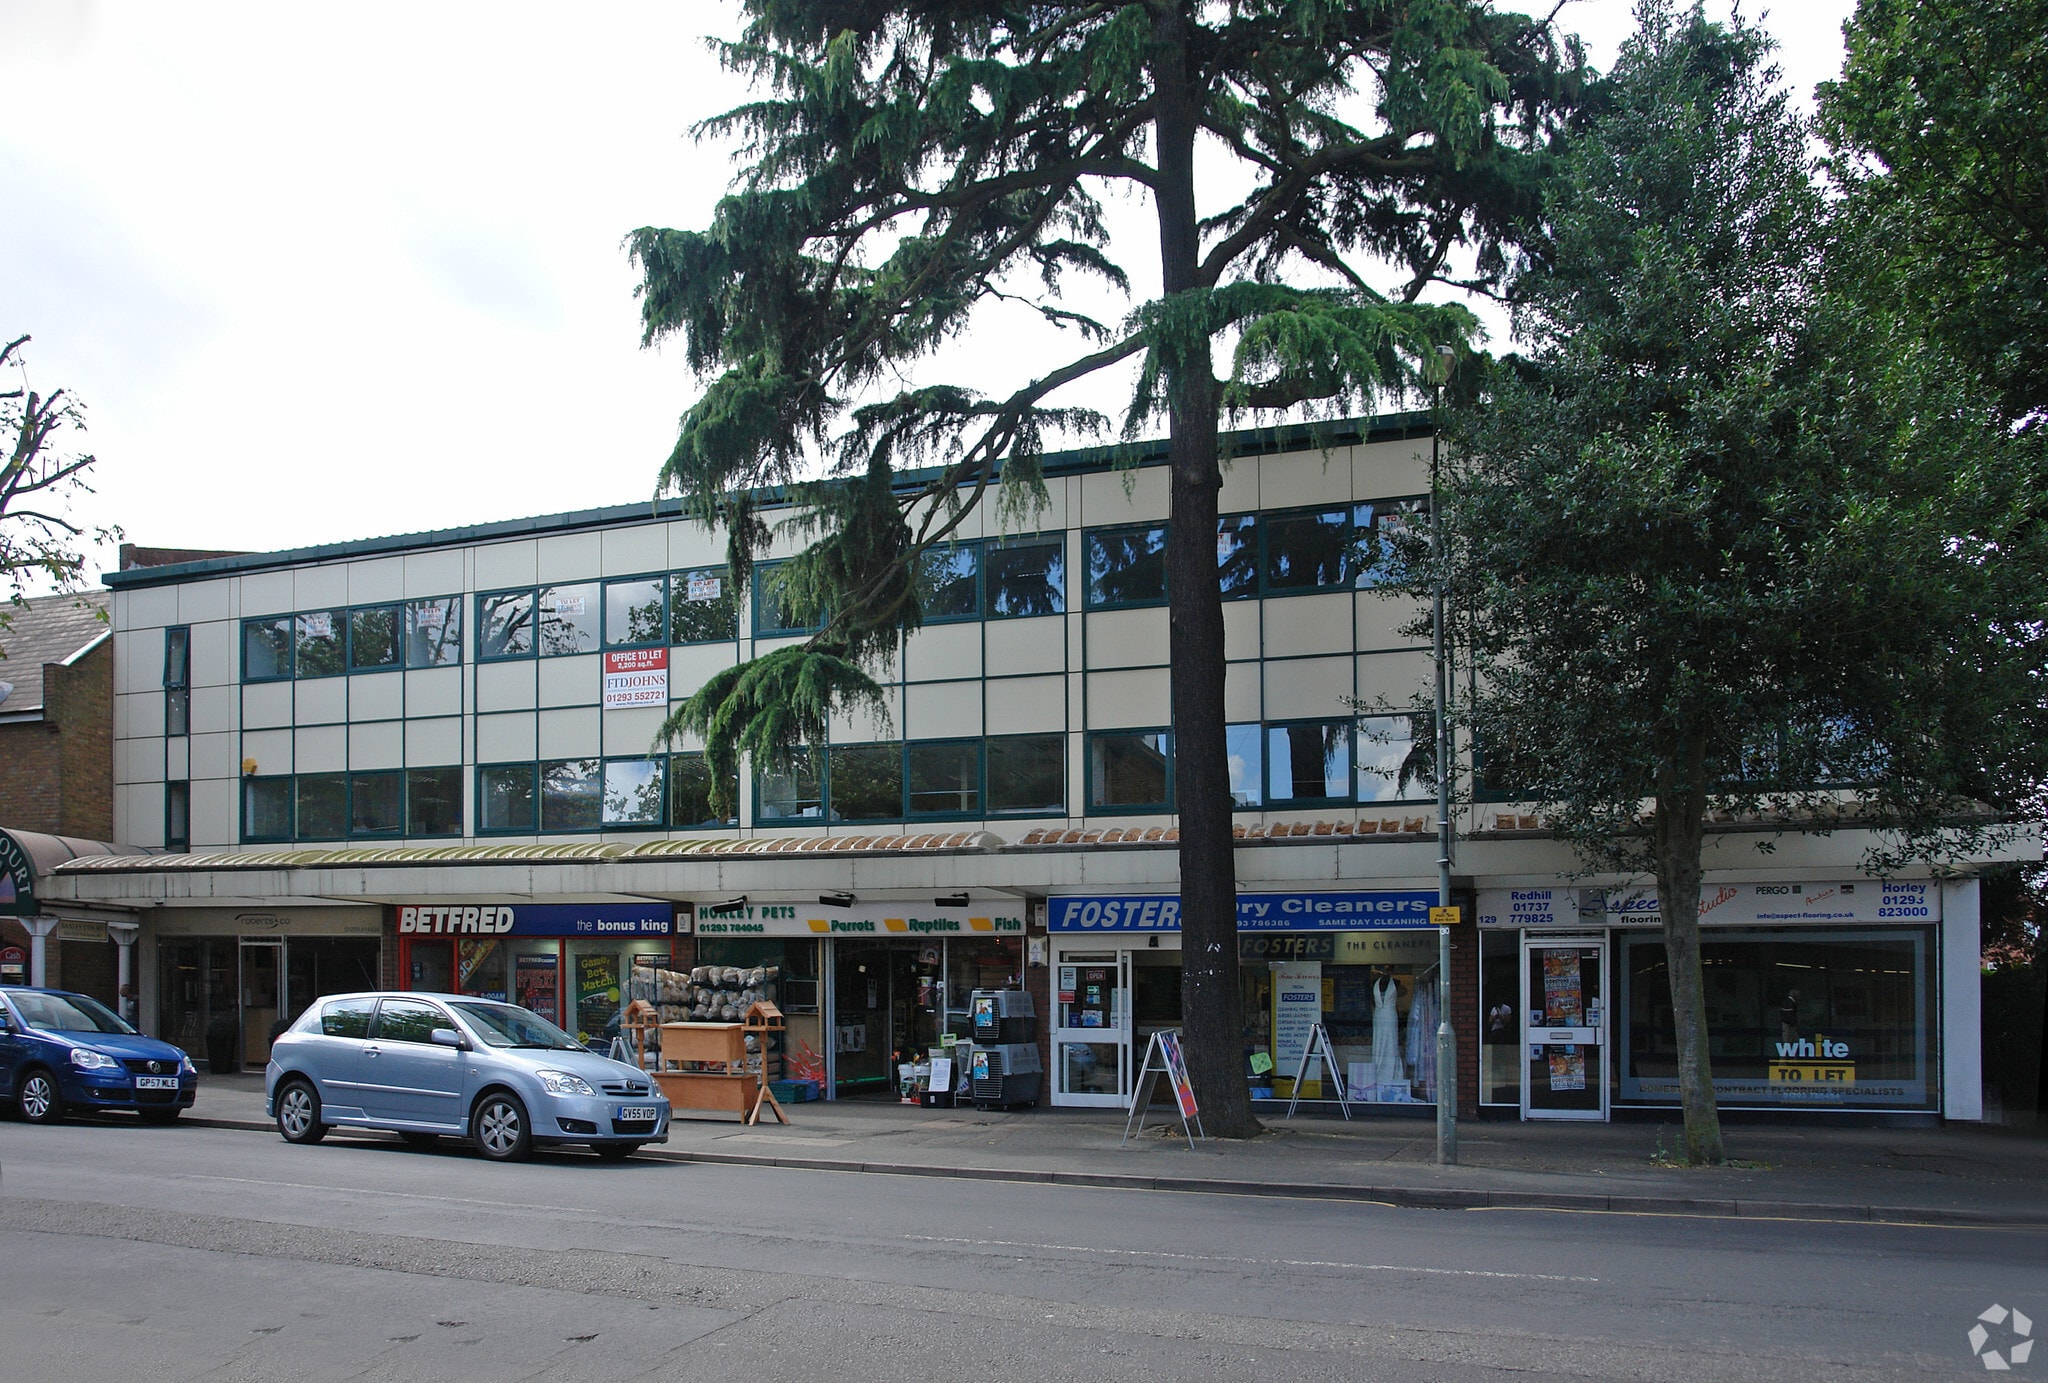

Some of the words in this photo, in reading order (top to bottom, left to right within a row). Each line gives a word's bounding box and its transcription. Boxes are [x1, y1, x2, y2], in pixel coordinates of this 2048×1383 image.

[611, 653, 636, 663] OFFICE
[638, 651, 647, 660] TO
[649, 650, 663, 659] LET
[607, 675, 666, 689] FTDJOHNS
[606, 692, 633, 703] 01293
[634, 691, 665, 701] 552721
[1756, 887, 1789, 895] PERGO
[1882, 883, 1926, 894] Horley
[1511, 891, 1552, 900] Redhill
[1883, 895, 1925, 905] 01293
[761, 906, 796, 919] PETS
[1236, 902, 1270, 917] ry
[1281, 898, 1428, 912] Cleaners
[1514, 903, 1549, 912] 01737
[1878, 907, 1928, 917] 823000
[399, 906, 515, 934] BETFRED
[1062, 901, 1181, 928] FOSTER
[1374, 917, 1427, 925] CLEANING
[1510, 914, 1553, 923] 779825
[1620, 915, 1660, 923] floorin
[577, 919, 593, 931] the
[597, 919, 636, 931] bonus
[641, 919, 669, 933] king
[699, 923, 727, 932] 01293
[831, 919, 876, 932] Parrots
[908, 918, 961, 934] Reptiles
[995, 917, 1022, 931] Fish
[1243, 938, 1332, 953] FOSTERS
[1346, 941, 1366, 949] THE
[1373, 940, 1432, 949] CLEANERS
[581, 956, 610, 969] Game,
[587, 966, 609, 979] Bet,
[582, 976, 617, 991] Match!
[1776, 1033, 1849, 1057] white
[140, 1078, 160, 1087] GP57
[1779, 1069, 1802, 1083] TO
[1815, 1070, 1846, 1084] LET
[623, 1108, 641, 1119] GV55
